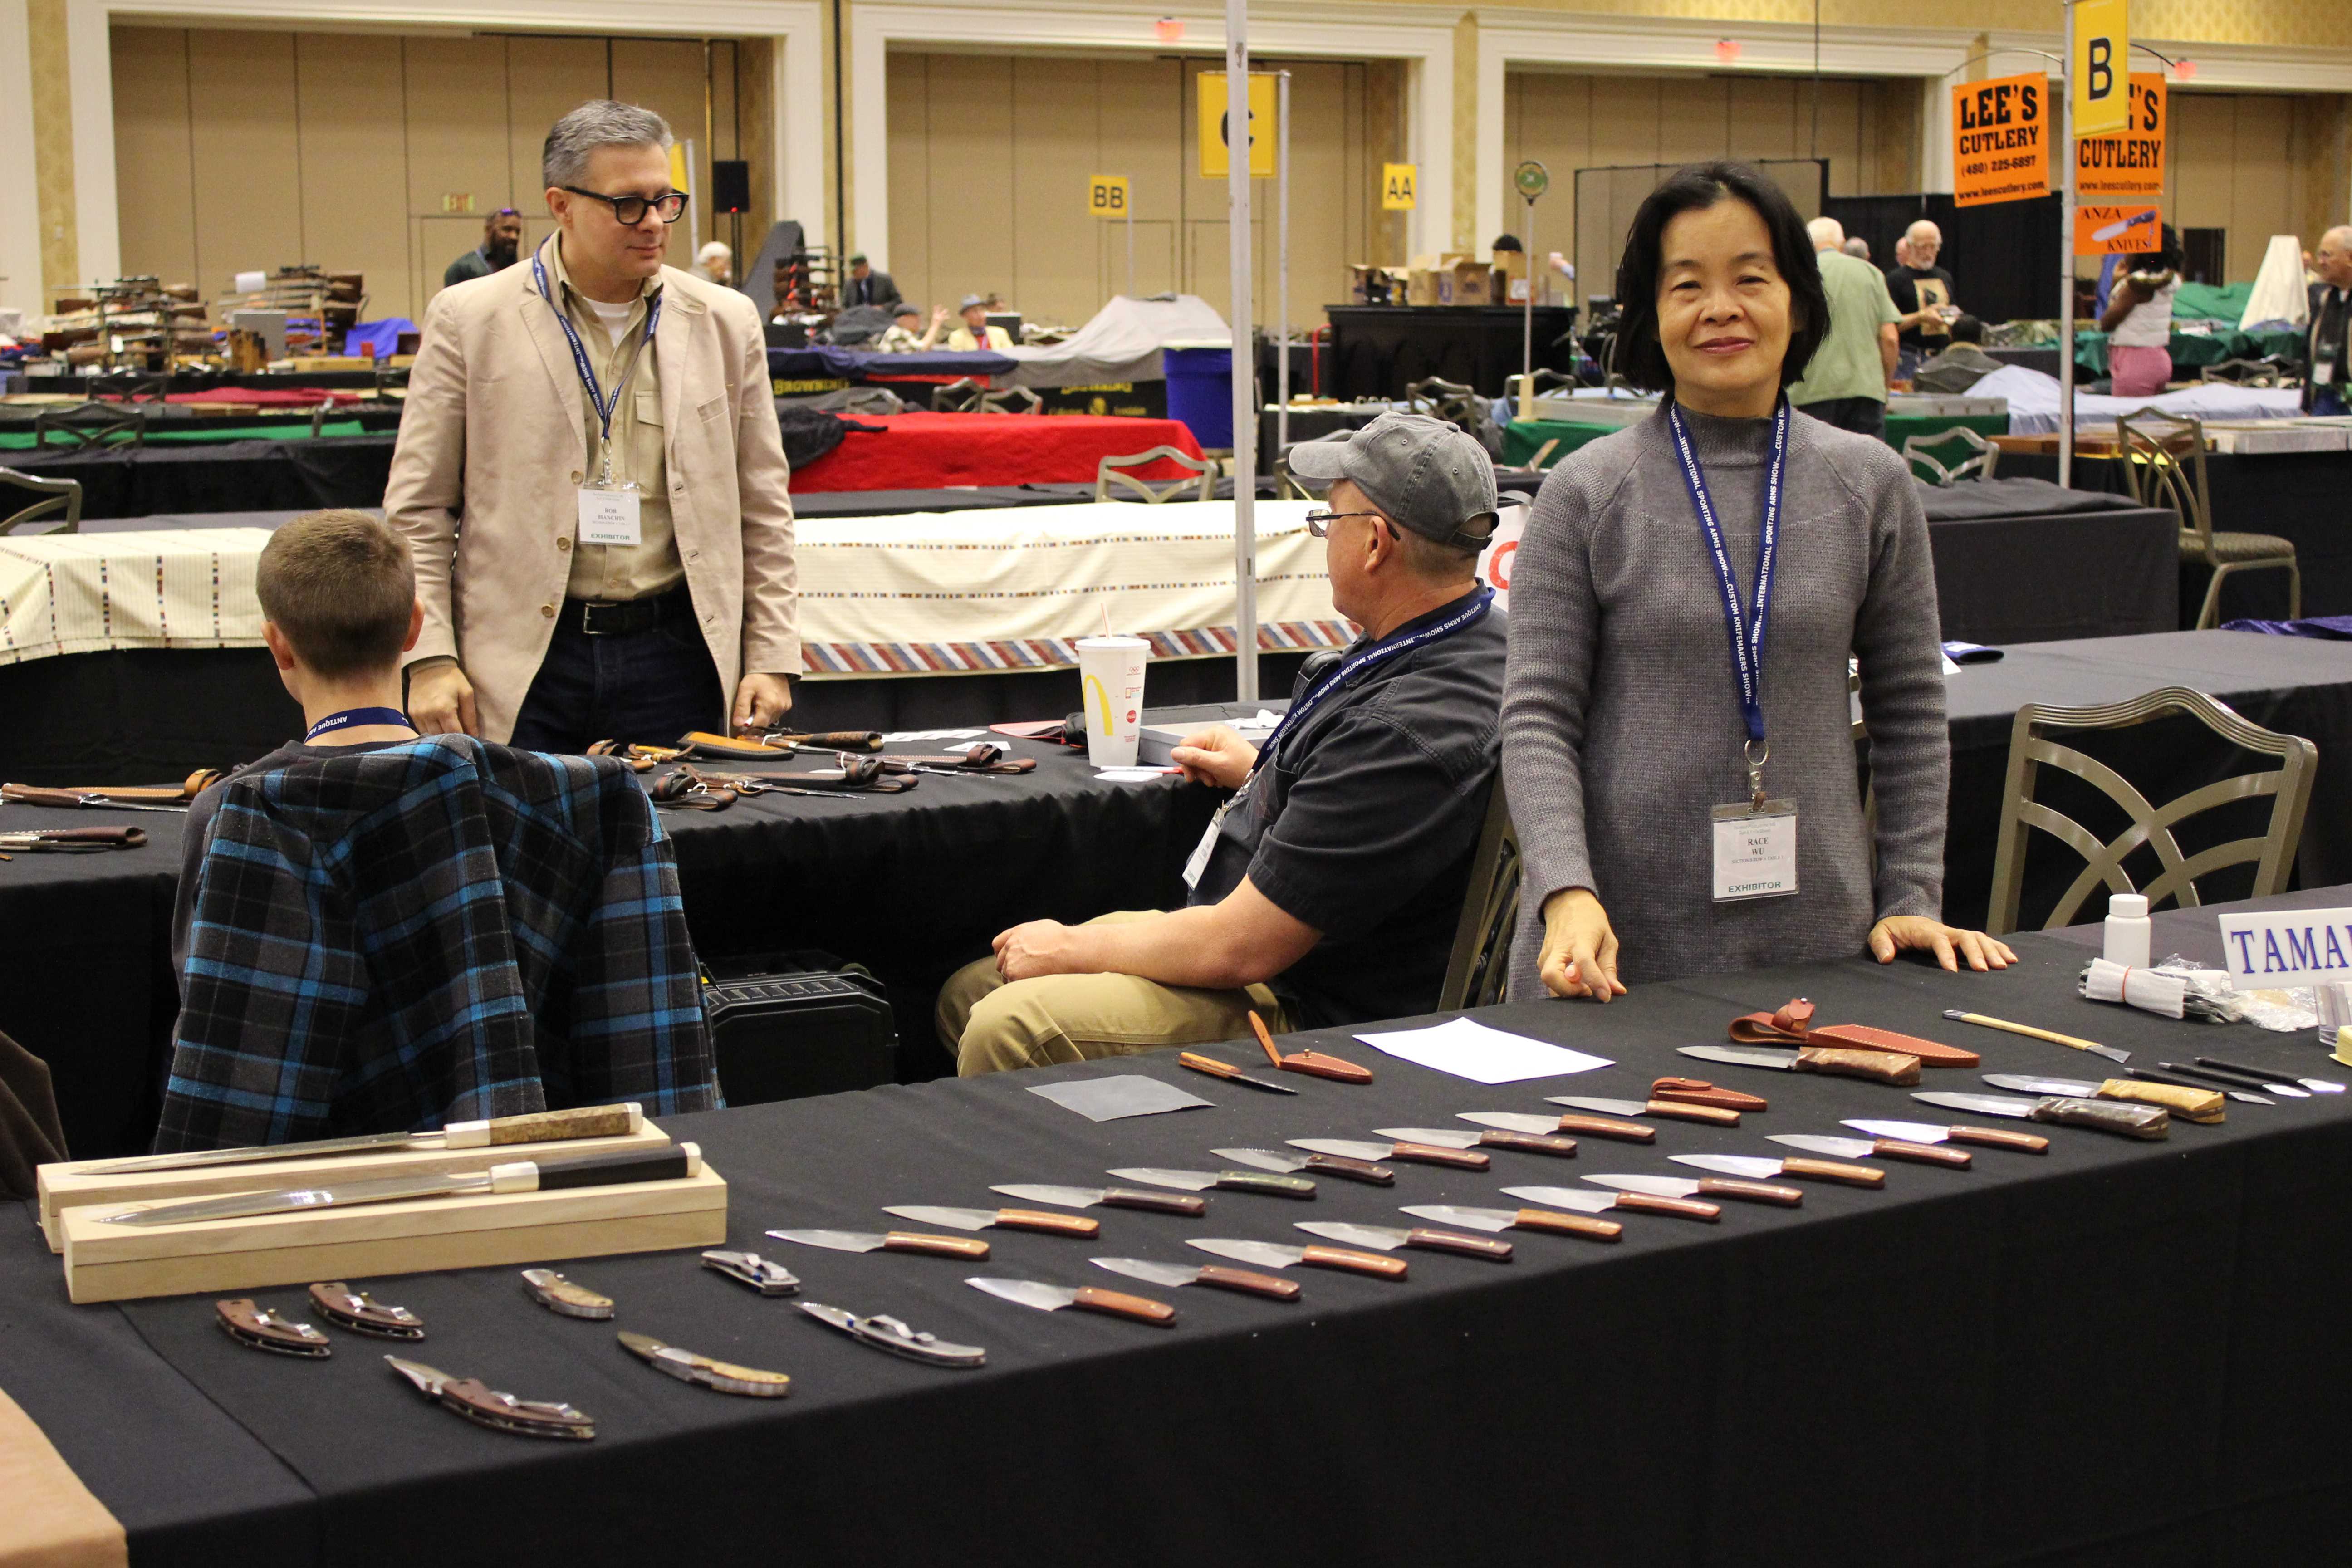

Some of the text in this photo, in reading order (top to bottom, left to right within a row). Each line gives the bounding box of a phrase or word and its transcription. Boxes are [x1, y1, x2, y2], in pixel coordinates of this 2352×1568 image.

[2089, 38, 2113, 101] B
[1960, 84, 2038, 130] LEE'S
[1960, 125, 2038, 155] CUTLERY
[2080, 139, 2161, 168] CUTLERY
[1961, 162, 1988, 178] (480)
[1094, 185, 1123, 208] BB
[1387, 176, 1414, 200] AA
[1958, 181, 2045, 200] www.leescutlery.com
[2082, 207, 2122, 220] ANZA
[1774, 419, 1785, 450] CUSTOM
[1769, 485, 1777, 506] ARMS
[1765, 506, 1776, 545] SPORTING
[590, 533, 630, 541] EXHIBITOR
[1679, 436, 1702, 490] INTERNATIONAL
[1696, 490, 1715, 527] SPORTING
[1709, 527, 1721, 548] ARMS
[1726, 583, 1740, 615] CUSTOM
[1733, 616, 1748, 671] KNIFEMAKERS
[1756, 545, 1772, 608] INTERNATIONAL
[1462, 602, 1482, 621] ANTIQUE
[1444, 617, 1460, 630] ARMS
[1367, 637, 1416, 661] INTERNATIONAL
[1341, 657, 1367, 677] SPORTING
[1329, 675, 1342, 687] ARMS
[1297, 700, 1313, 716] CUSTOM
[317, 715, 348, 731] ANTIQUE
[1748, 837, 1769, 846] RACE
[1728, 881, 1781, 893] EXHIBITOR
